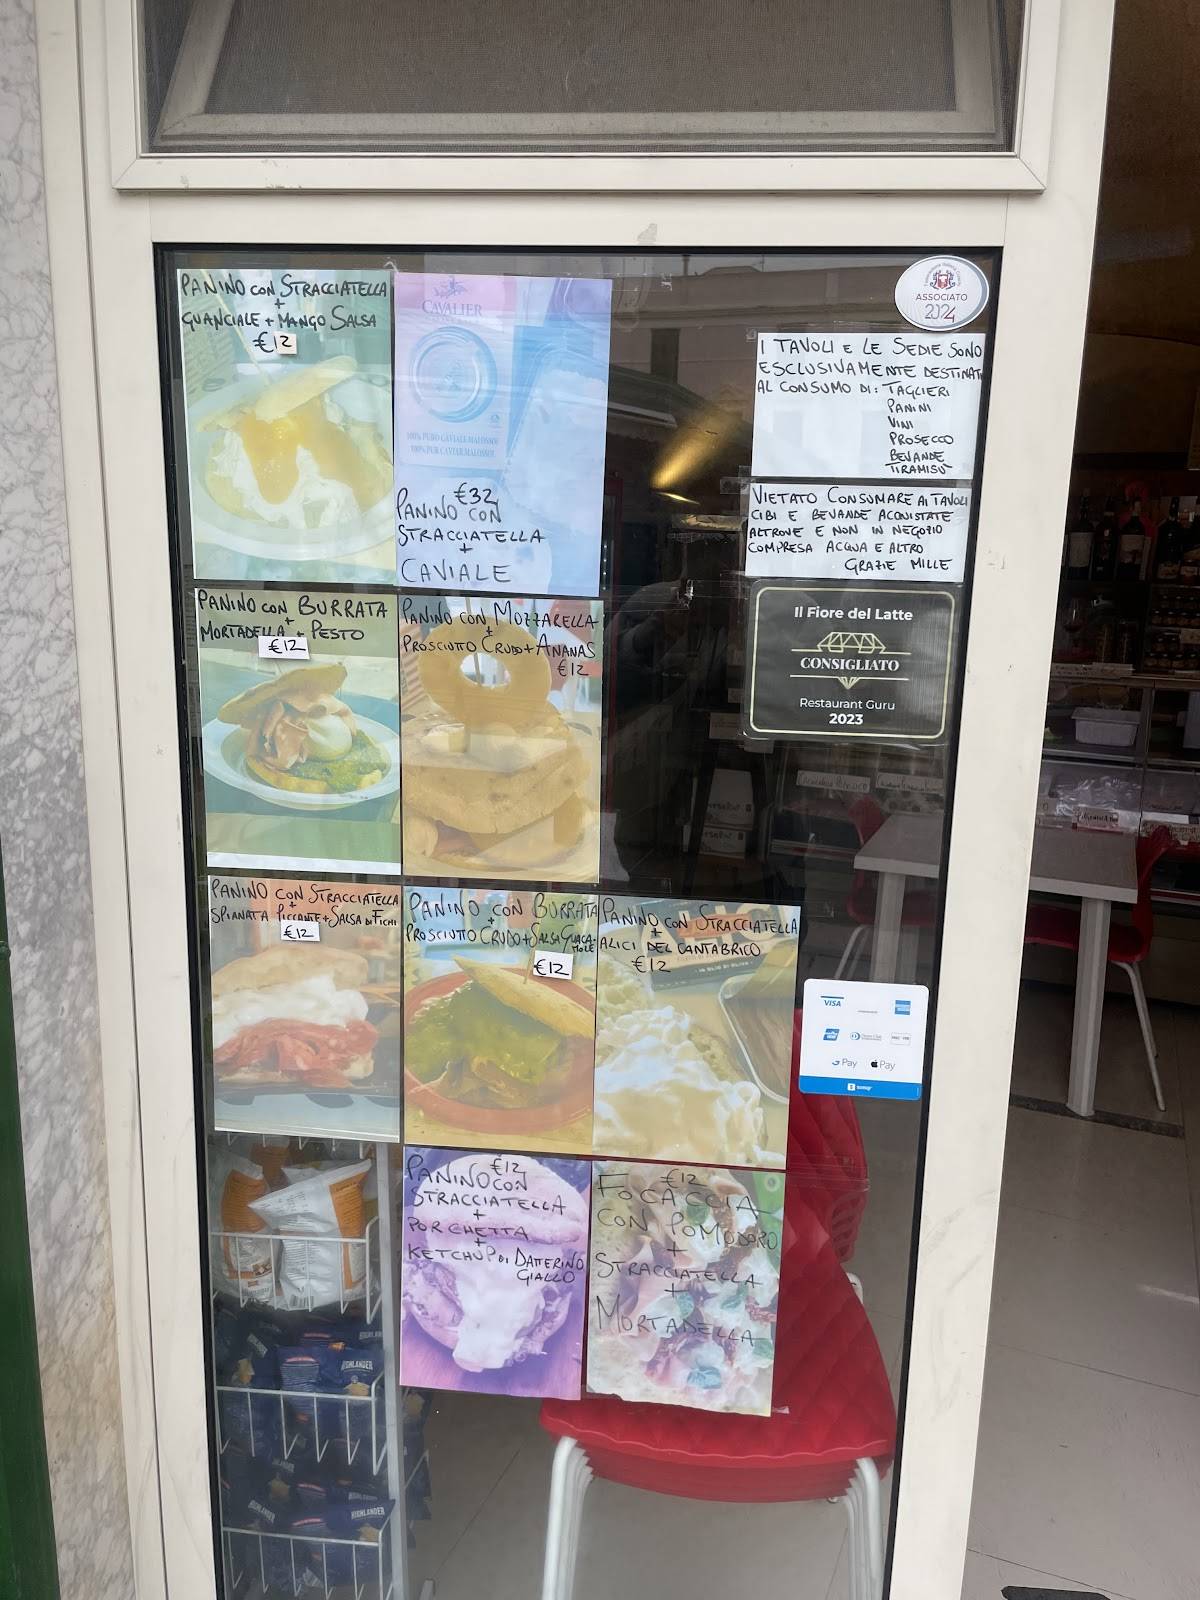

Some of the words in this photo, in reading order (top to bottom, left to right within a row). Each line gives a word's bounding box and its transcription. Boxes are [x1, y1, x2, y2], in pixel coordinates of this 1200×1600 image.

[181, 273, 245, 296] PANINO
[250, 279, 276, 296] CON
[280, 274, 386, 297] STRACCIATELLA
[274, 298, 285, 309] +
[915, 293, 968, 301] ASSOCIATO
[182, 308, 260, 332] GUANCIALE
[265, 316, 274, 325] +
[278, 313, 326, 332] MANGO
[331, 305, 376, 330] SALSA
[925, 303, 956, 323] 2024
[252, 332, 292, 353] €12
[761, 340, 765, 354] I
[773, 338, 834, 354] TAVOLI
[843, 344, 853, 354] E
[862, 338, 882, 355] LE
[892, 337, 943, 357] SEDIE
[948, 341, 982, 358] SONO
[759, 358, 916, 377] ESCLUSIVAMENTE
[757, 381, 773, 393] AL
[779, 381, 852, 394] CONSUMO
[860, 384, 879, 394] DI:
[882, 381, 950, 399] TAGLIERI
[887, 399, 932, 414] PANINI
[888, 416, 914, 430] VINI
[889, 432, 955, 446] PROSECCO
[890, 449, 945, 463] BEVANDE
[454, 483, 497, 505] €32
[752, 485, 818, 505] VIETATO
[827, 486, 914, 505] CONSUMARE
[917, 494, 928, 506] AI
[930, 492, 968, 507] TAVOLI
[397, 487, 457, 521] PANINO
[469, 499, 502, 523] CON
[751, 509, 777, 521] CIBI
[788, 510, 798, 522] E
[811, 509, 872, 520] BEVANDE
[398, 525, 546, 546] STRACCIATELLA
[749, 527, 805, 538] ALTROVE
[815, 525, 825, 537] E
[832, 524, 859, 536] NON
[872, 525, 884, 535] IN
[892, 524, 943, 539] NEGOZIO
[459, 543, 473, 553] +
[748, 541, 813, 554] COMPRESA
[826, 541, 868, 554] ACQUA
[875, 543, 883, 552] E
[889, 542, 924, 554] ALTRO
[401, 558, 512, 582] CAVIALE
[844, 559, 897, 576] GRAZIE
[911, 559, 953, 571] MILLE
[198, 590, 256, 613] PANINO
[262, 600, 288, 614] CON
[299, 595, 388, 618] BURRATA
[402, 597, 452, 625] PANINO
[460, 607, 487, 625] CON
[494, 600, 599, 629] MOZZARELLA
[284, 617, 294, 626] +
[794, 606, 803, 618] Il
[807, 606, 845, 619] Fiore
[847, 607, 871, 620] del
[874, 608, 914, 621] Latte
[200, 620, 285, 641] MORTADELLA
[311, 620, 365, 640] PESTO
[486, 626, 493, 636] +
[268, 639, 306, 654] €12
[403, 635, 477, 653] PROSCIUTTO
[536, 634, 596, 658] ANANAS
[557, 659, 589, 677] €12
[800, 657, 900, 672] CONSIGLIATO
[800, 698, 863, 710] Restaurant
[865, 700, 896, 711] Guru
[828, 713, 864, 725] 2023
[212, 878, 268, 899] PANINO
[275, 884, 303, 900] CON
[309, 884, 399, 906] STRACCIATELLA
[289, 901, 296, 909] +
[409, 890, 480, 923] PANINO
[493, 899, 523, 916] CON
[532, 893, 597, 920] BURRATA
[211, 906, 269, 923] SPIANATA
[328, 905, 362, 928] SALSA
[372, 909, 397, 926] FICHI
[488, 917, 495, 925] +
[602, 897, 659, 927] PANINO
[664, 913, 688, 929] CON
[696, 903, 798, 935] STRACCIATELLA
[283, 925, 314, 939] €12
[406, 924, 476, 942] PROSCIUTTO
[480, 925, 520, 947] CRUDO
[530, 923, 560, 948] SALSA
[650, 928, 662, 937] +
[572, 945, 595, 953] MOLE
[600, 937, 636, 951] ALICI
[647, 942, 672, 954] DEL
[677, 942, 761, 957] CANTABRICO
[533, 959, 570, 976] €12
[631, 956, 672, 973] €12
[841, 1058, 858, 1069] Pay
[879, 1060, 896, 1071] Pay
[406, 1154, 490, 1188] PANINO
[493, 1171, 528, 1191] CON
[490, 1158, 525, 1176] €12
[660, 1169, 707, 1189] €12
[411, 1186, 567, 1215] STRACCIATELLA
[597, 1173, 772, 1220] FOCACCIA
[473, 1208, 486, 1222] +
[408, 1217, 529, 1240] PORCHETTA
[597, 1208, 649, 1232] CON
[670, 1211, 778, 1250] POMODORO
[474, 1237, 486, 1247] +
[667, 1242, 688, 1257] +
[408, 1243, 496, 1262] KETCHUP
[514, 1247, 584, 1270] DATTERINO
[517, 1269, 576, 1288] GIALLO
[595, 1252, 764, 1288] STRACCIATELLA
[664, 1283, 689, 1298] +
[596, 1293, 769, 1347] MORTADELLA
